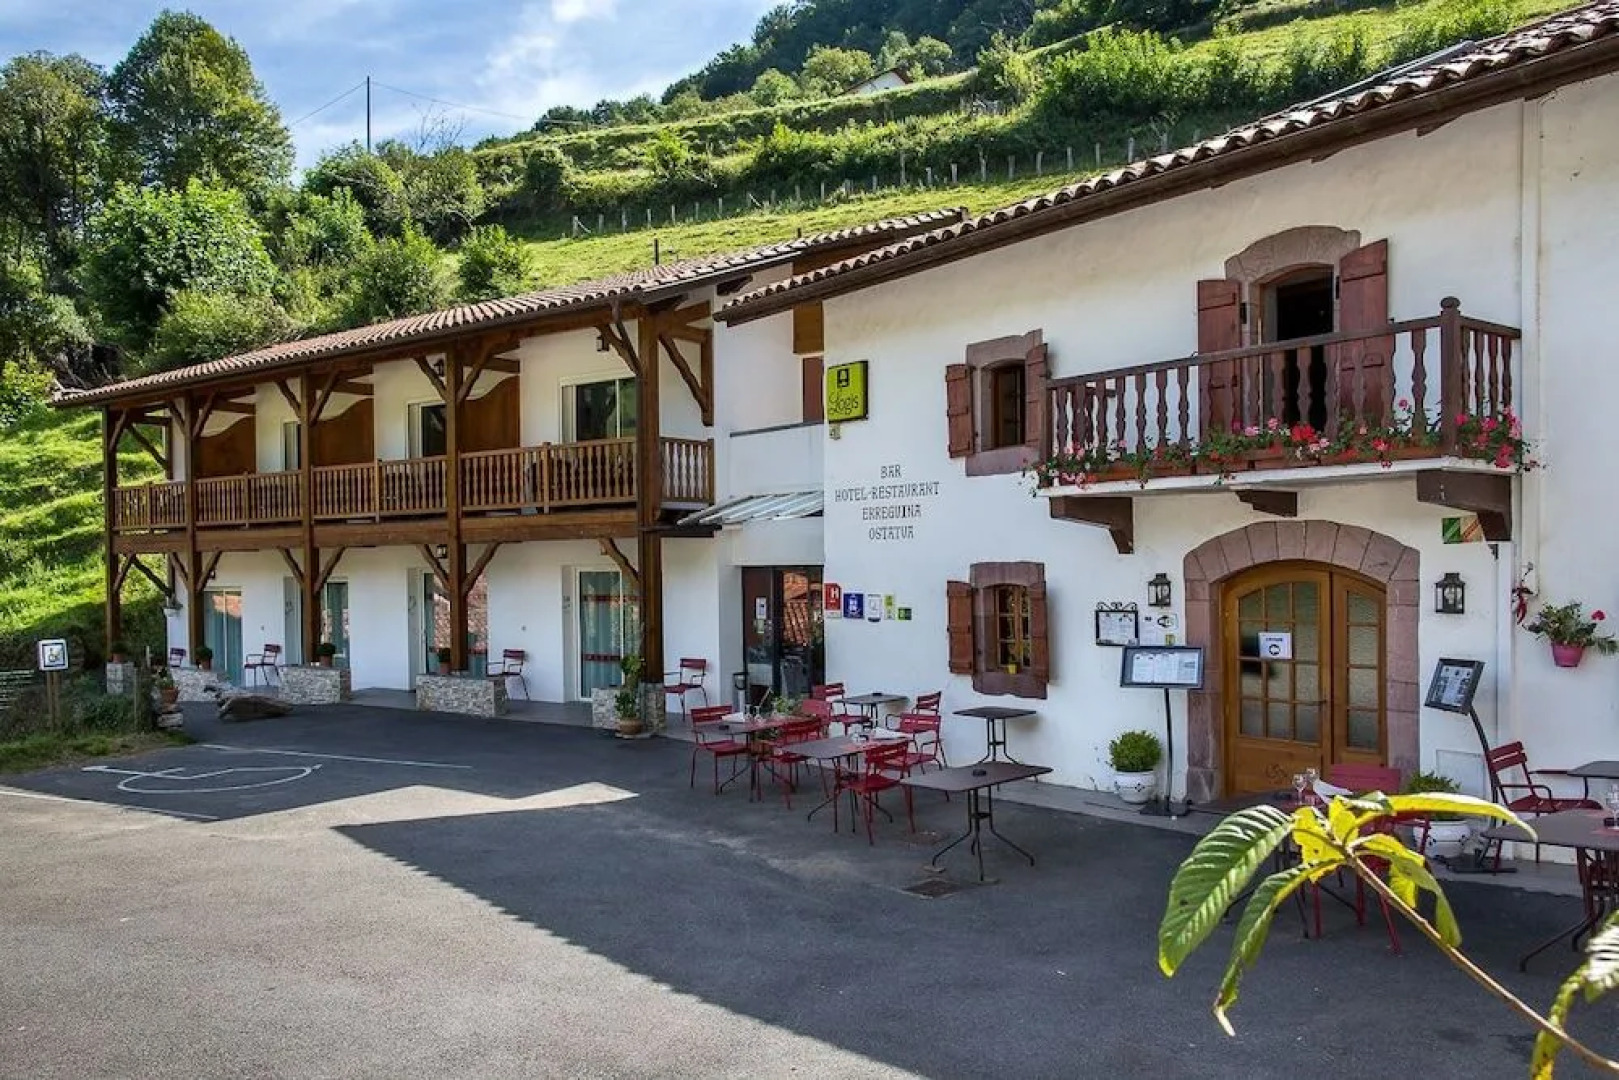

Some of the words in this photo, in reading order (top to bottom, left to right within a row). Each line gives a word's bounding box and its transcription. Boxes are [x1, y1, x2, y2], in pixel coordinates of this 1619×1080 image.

[880, 464, 902, 479] BAR
[834, 481, 940, 502] HOTEL-RESTAURANT
[862, 505, 921, 520] ERREGUINA
